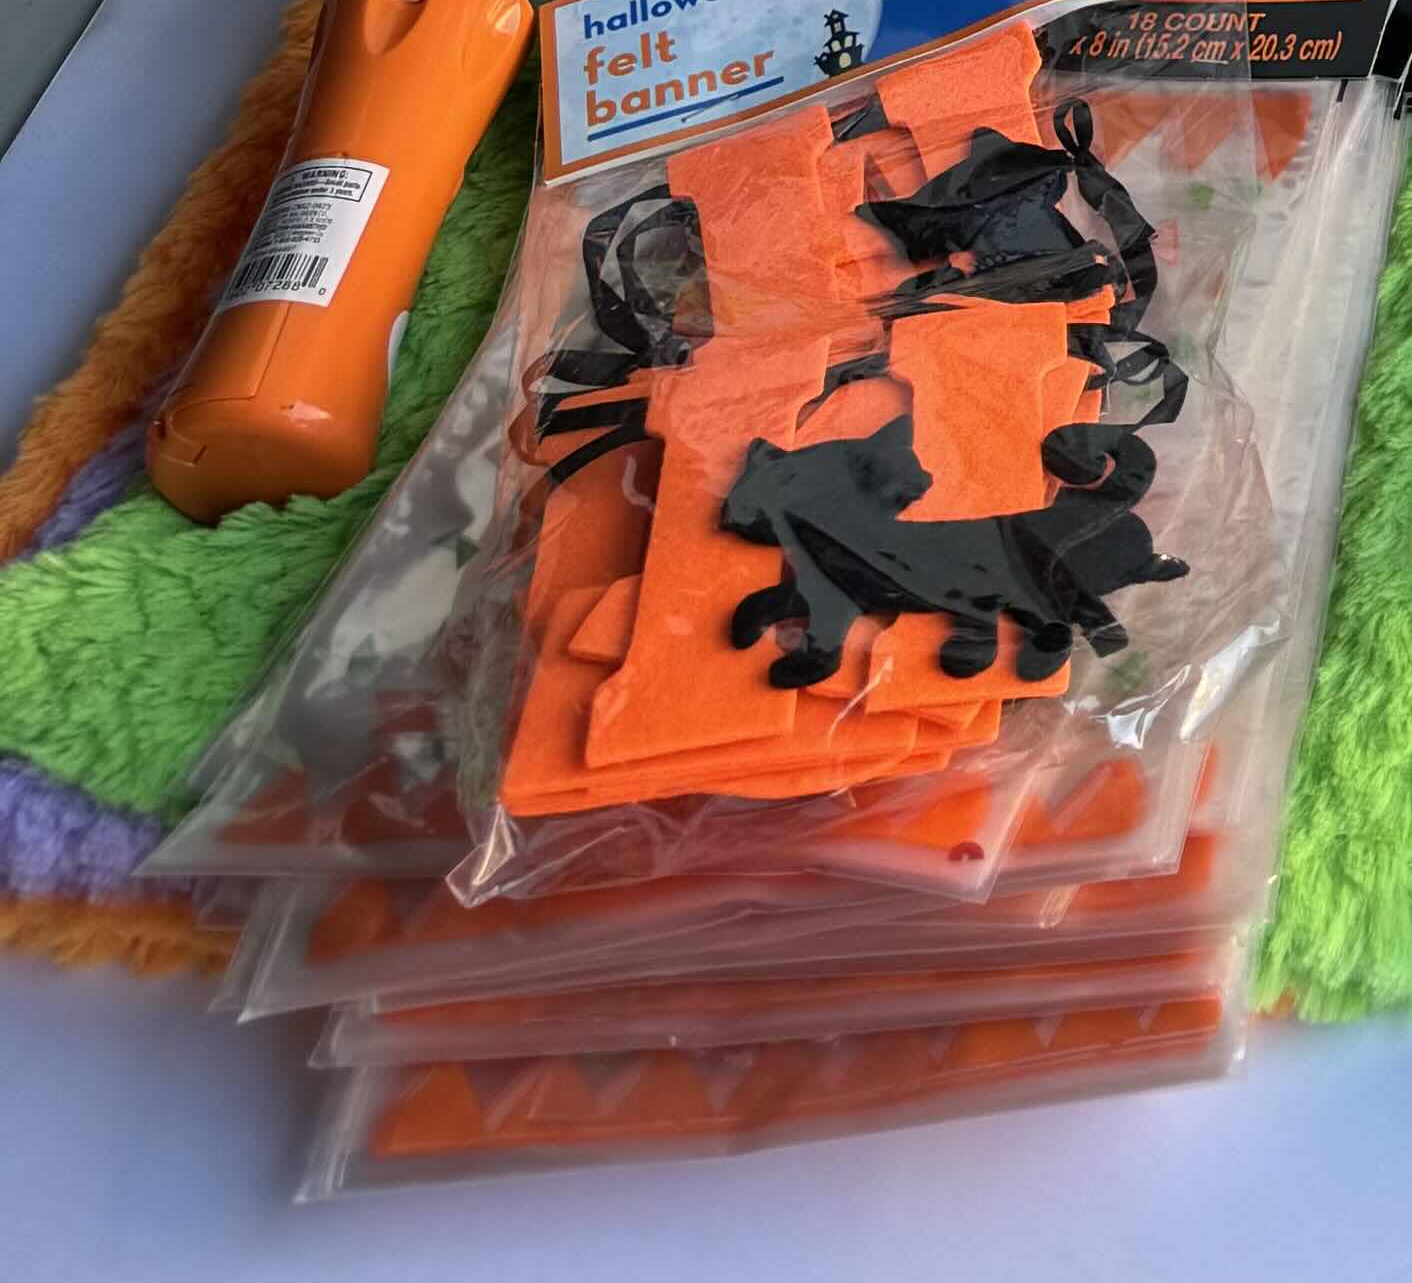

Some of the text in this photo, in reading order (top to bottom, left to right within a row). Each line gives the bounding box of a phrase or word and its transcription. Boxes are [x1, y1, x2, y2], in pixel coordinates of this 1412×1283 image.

[1128, 12, 1267, 33] 18 COUNT
[584, 30, 679, 86] felt
[1089, 30, 1344, 62] 8 in (15.2 cm x 20.3 cm)
[586, 50, 775, 127] banner
[302, 169, 349, 180] WARNING:
